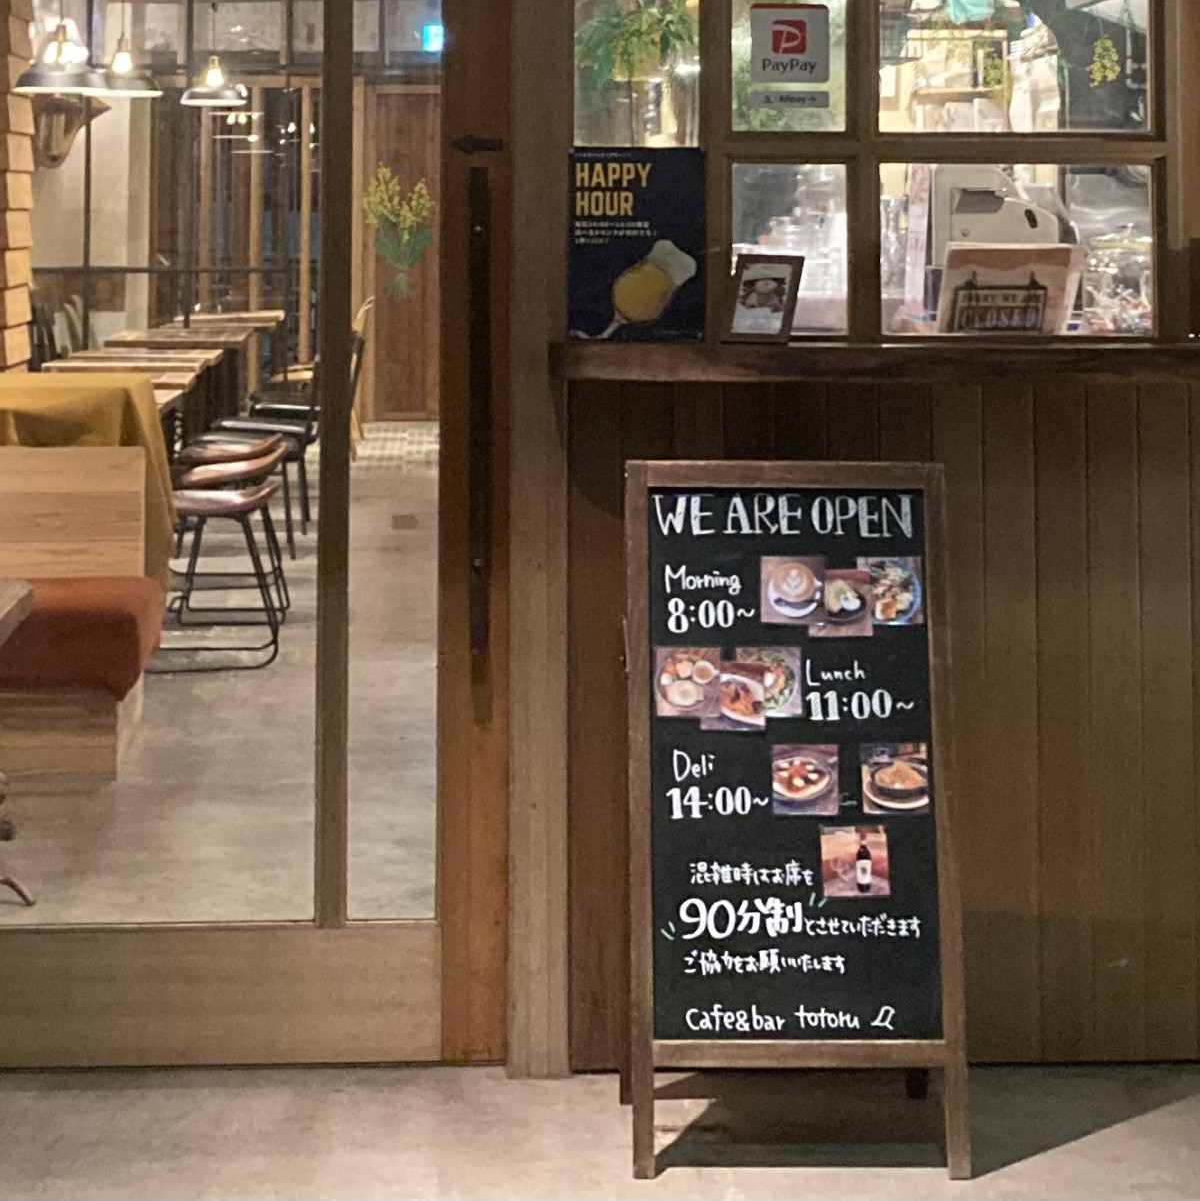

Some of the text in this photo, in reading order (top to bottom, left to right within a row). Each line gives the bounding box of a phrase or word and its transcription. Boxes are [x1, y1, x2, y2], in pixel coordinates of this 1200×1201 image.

[762, 59, 817, 74] PayPay
[575, 162, 652, 188] HAPPY
[575, 190, 634, 216] HOUR
[652, 493, 914, 539] WE ARE OPEN
[665, 564, 742, 596] Morning
[805, 659, 866, 687] Lunch
[673, 749, 716, 782] Deli
[690, 860, 814, 886] 混雑時はお席を
[794, 1004, 861, 1030] totoru
